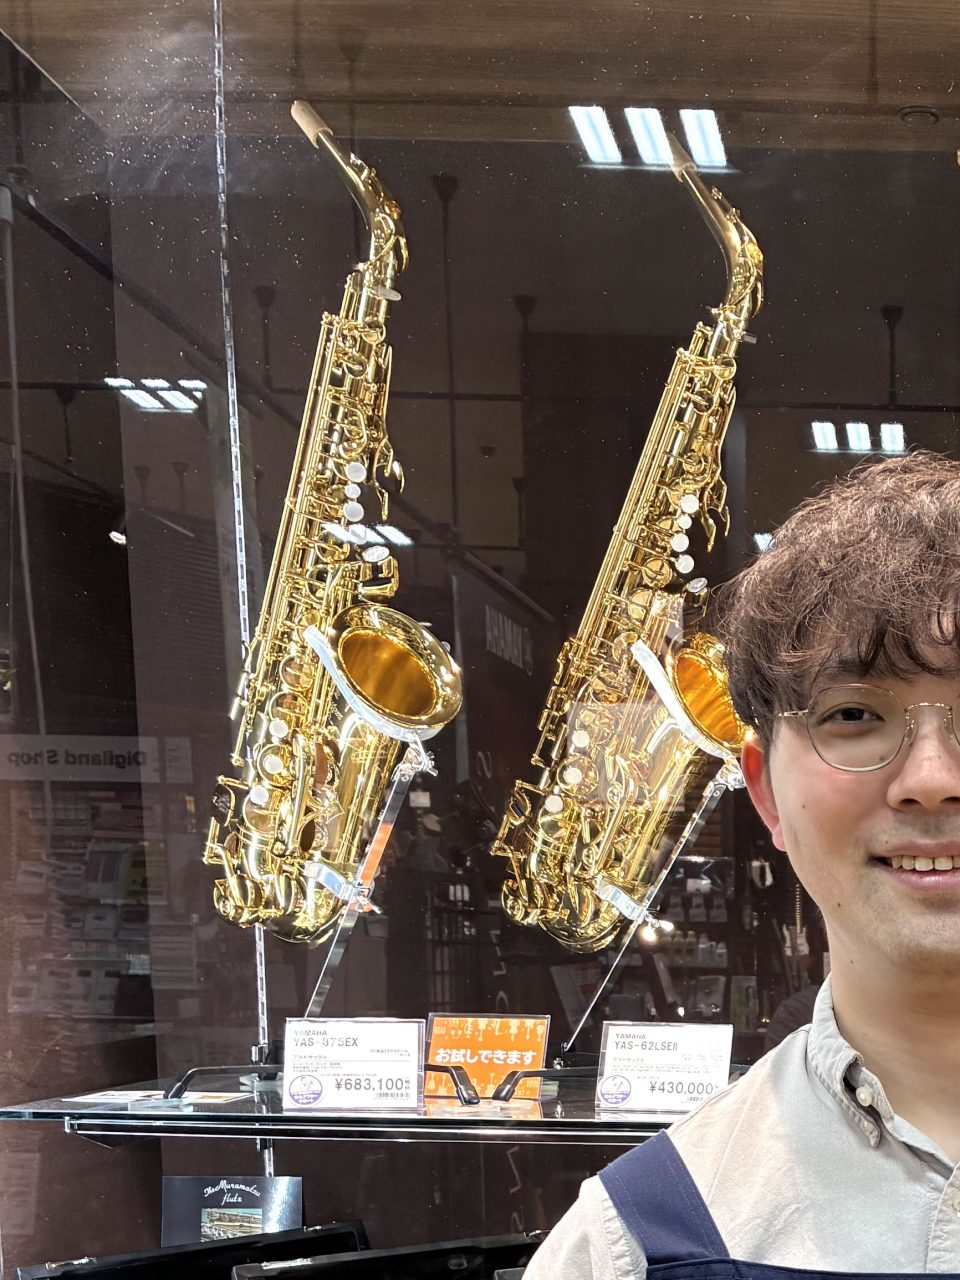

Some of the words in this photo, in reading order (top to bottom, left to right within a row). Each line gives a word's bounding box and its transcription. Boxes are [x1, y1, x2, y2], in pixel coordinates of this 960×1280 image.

[435, 1048, 537, 1065] お試しできます
[335, 1077, 404, 1092] ¥683,100
[649, 1080, 714, 1095] ¥430,000
